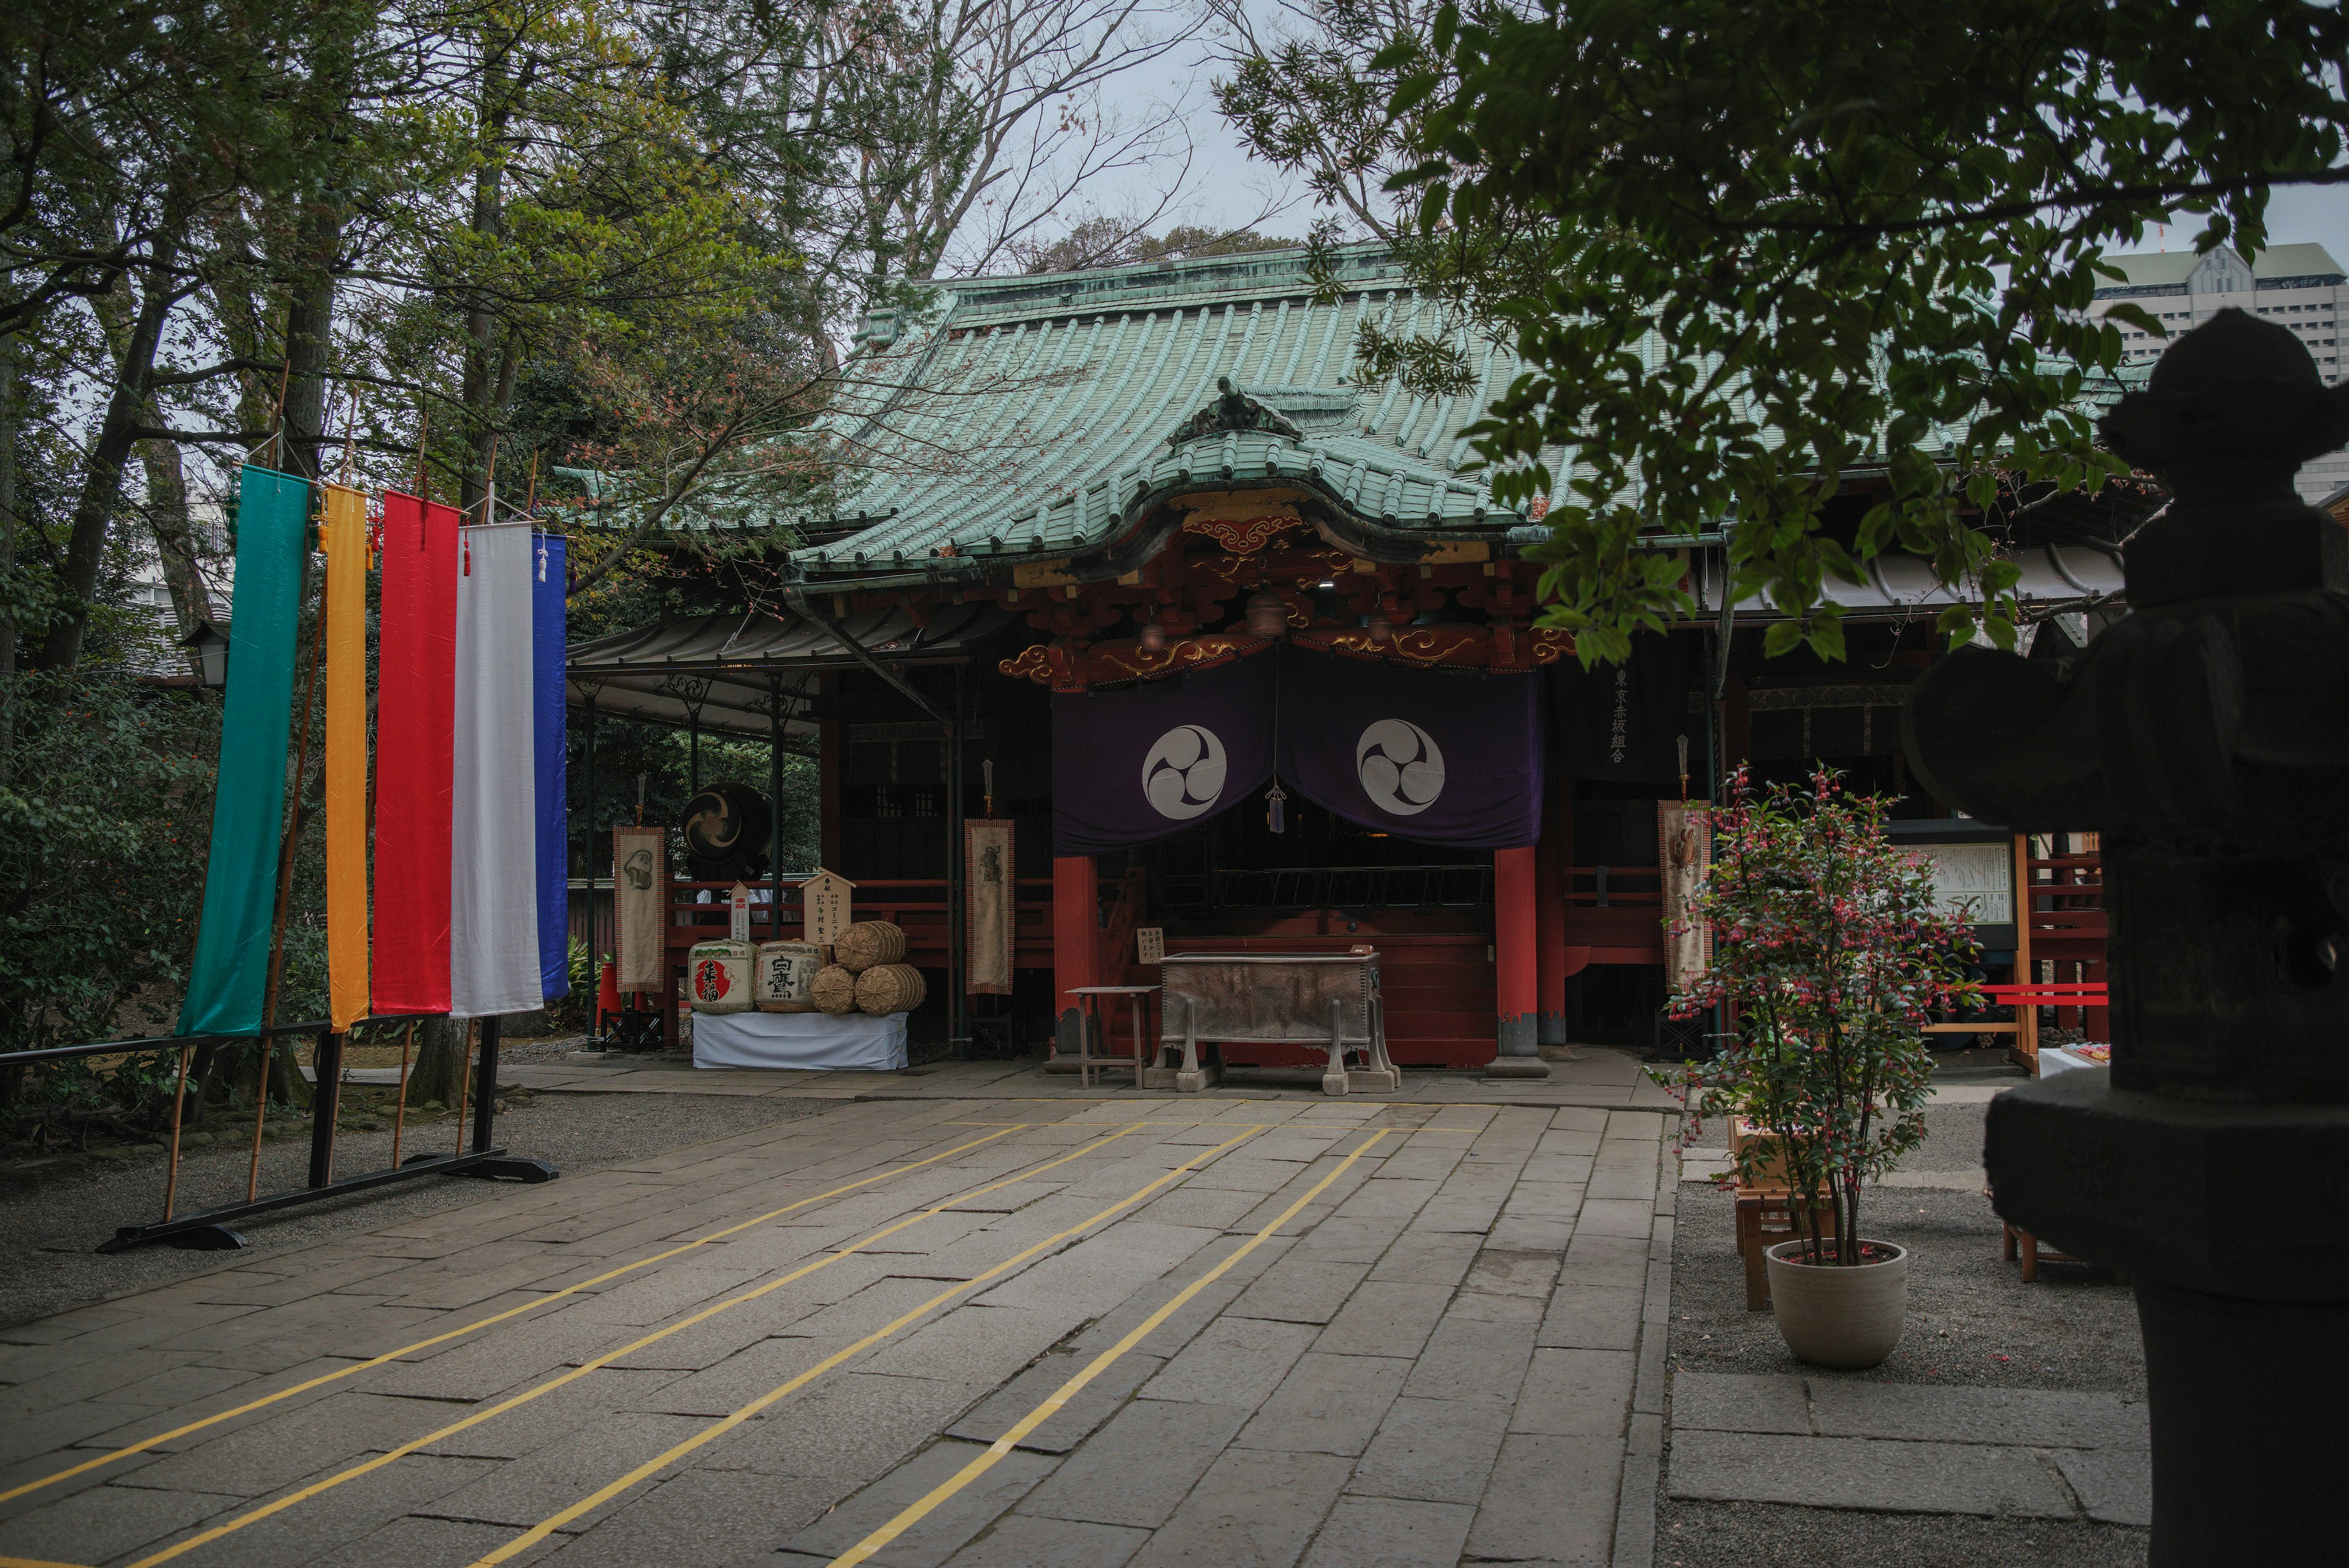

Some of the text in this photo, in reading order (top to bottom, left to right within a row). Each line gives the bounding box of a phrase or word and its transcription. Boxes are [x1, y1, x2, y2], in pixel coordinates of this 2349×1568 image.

[1609, 669, 1628, 763] 東京赤坂組合
[735, 897, 746, 909] 奉献
[824, 878, 831, 891] 奉献
[702, 960, 719, 1002] 来福
[768, 954, 796, 999] 白鷹
